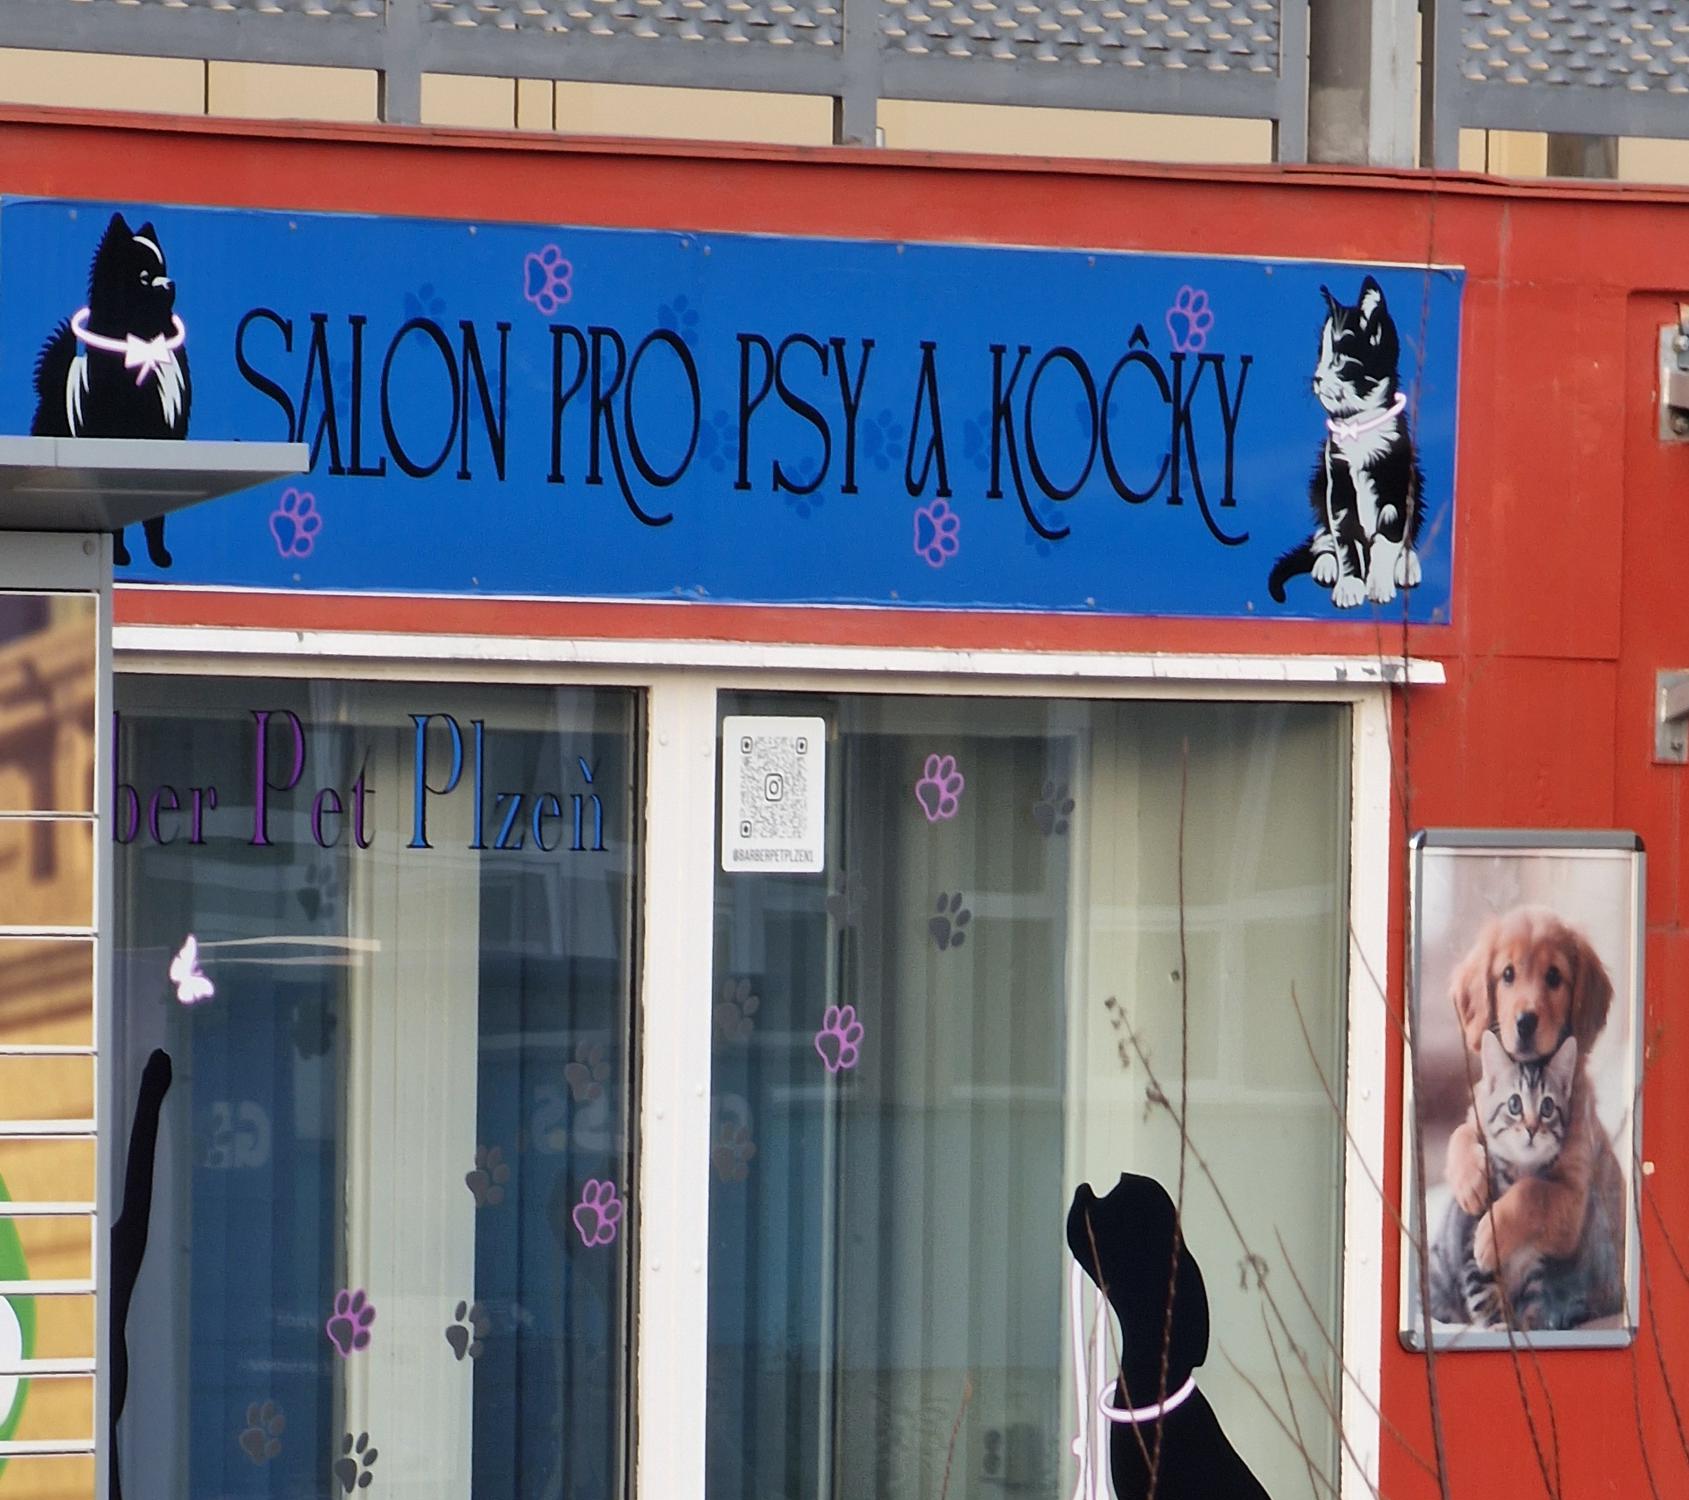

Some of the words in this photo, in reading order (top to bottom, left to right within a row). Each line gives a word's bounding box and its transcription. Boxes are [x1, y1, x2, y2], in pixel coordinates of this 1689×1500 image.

[234, 308, 511, 480] SALON
[547, 324, 700, 527] PRO
[733, 332, 875, 495] PSY
[905, 340, 953, 498] A
[247, 709, 377, 850] Pet
[406, 713, 609, 852] Plzeň
